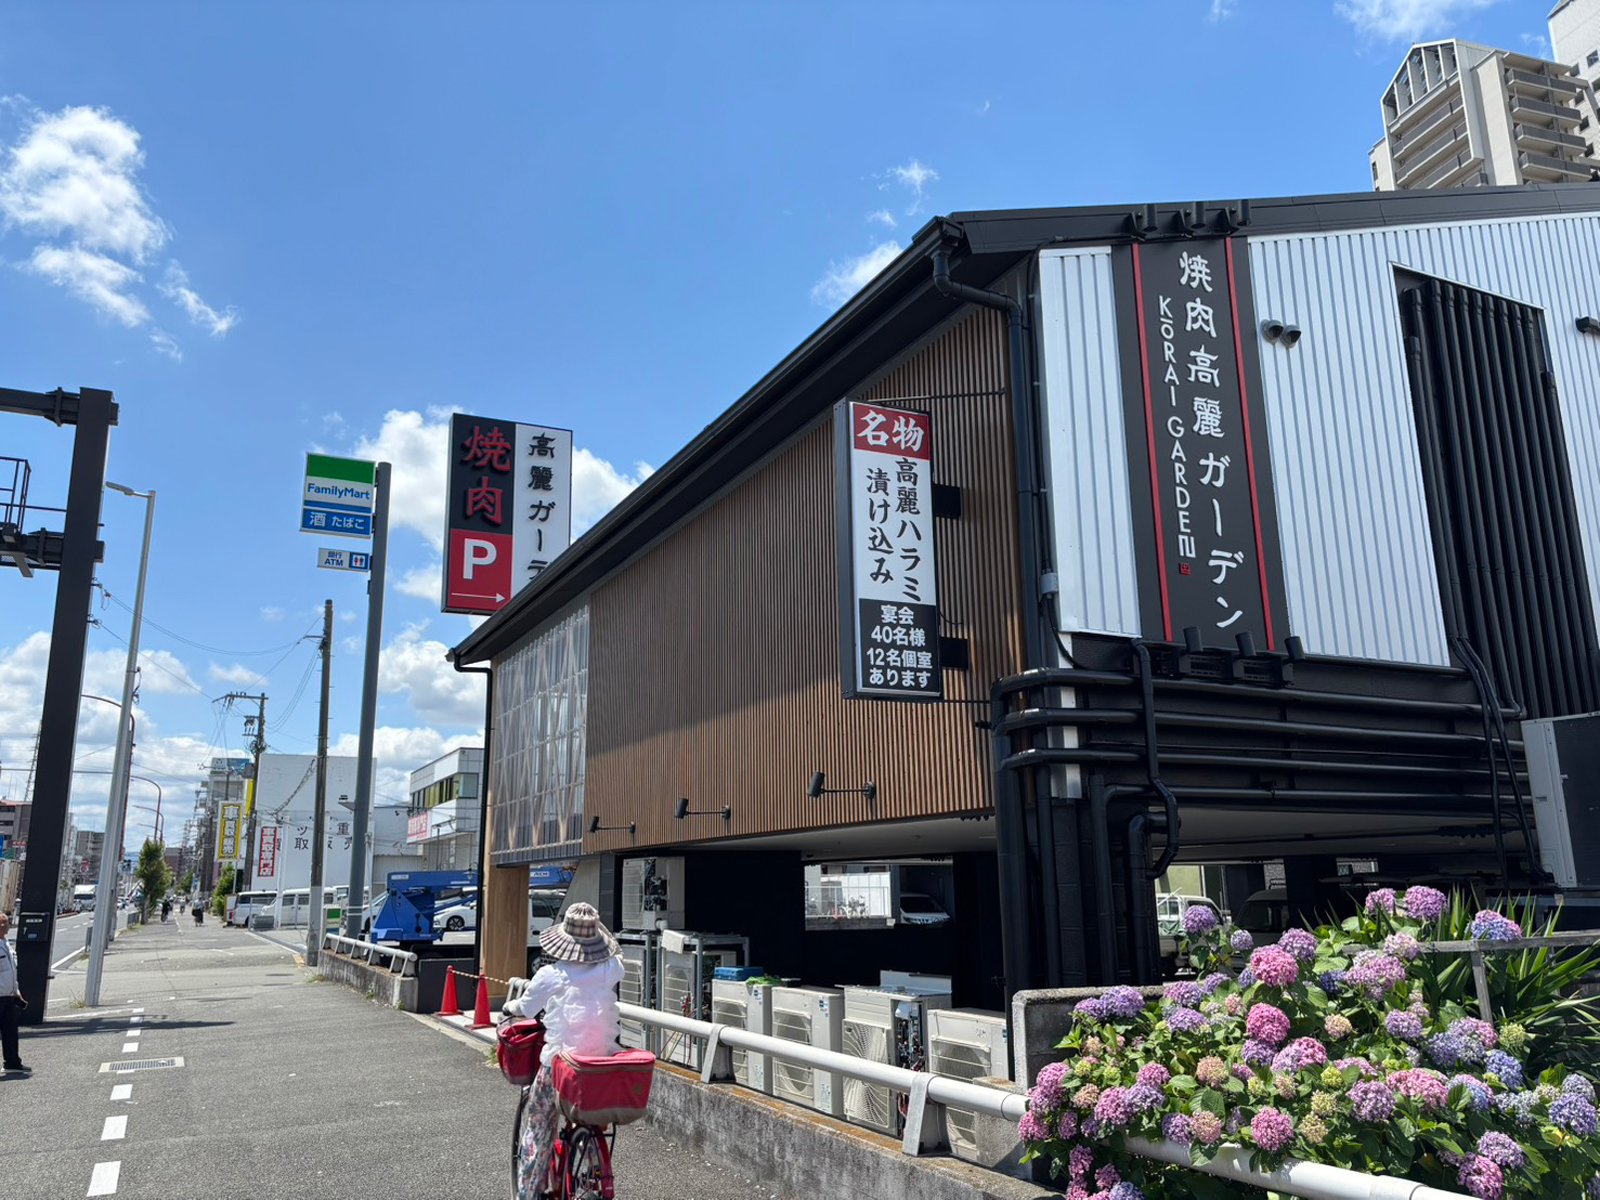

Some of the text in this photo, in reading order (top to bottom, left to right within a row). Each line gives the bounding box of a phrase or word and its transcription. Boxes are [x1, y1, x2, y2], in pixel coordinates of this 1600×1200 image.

[857, 409, 924, 452] 名物
[1179, 251, 1244, 628] 焼肉高麗ガーデン
[463, 425, 512, 526] 焼肉
[307, 483, 370, 500] FamilyMart
[310, 512, 365, 530] 酒 たばこ
[866, 467, 894, 584] 漬け込み
[895, 457, 921, 602] 高麗ハラミ
[324, 558, 343, 567] ATM
[463, 538, 497, 580] P
[881, 604, 914, 625] 宴会
[871, 625, 925, 647] 40名様
[866, 647, 932, 669] 12名個室
[869, 667, 931, 688] あります
